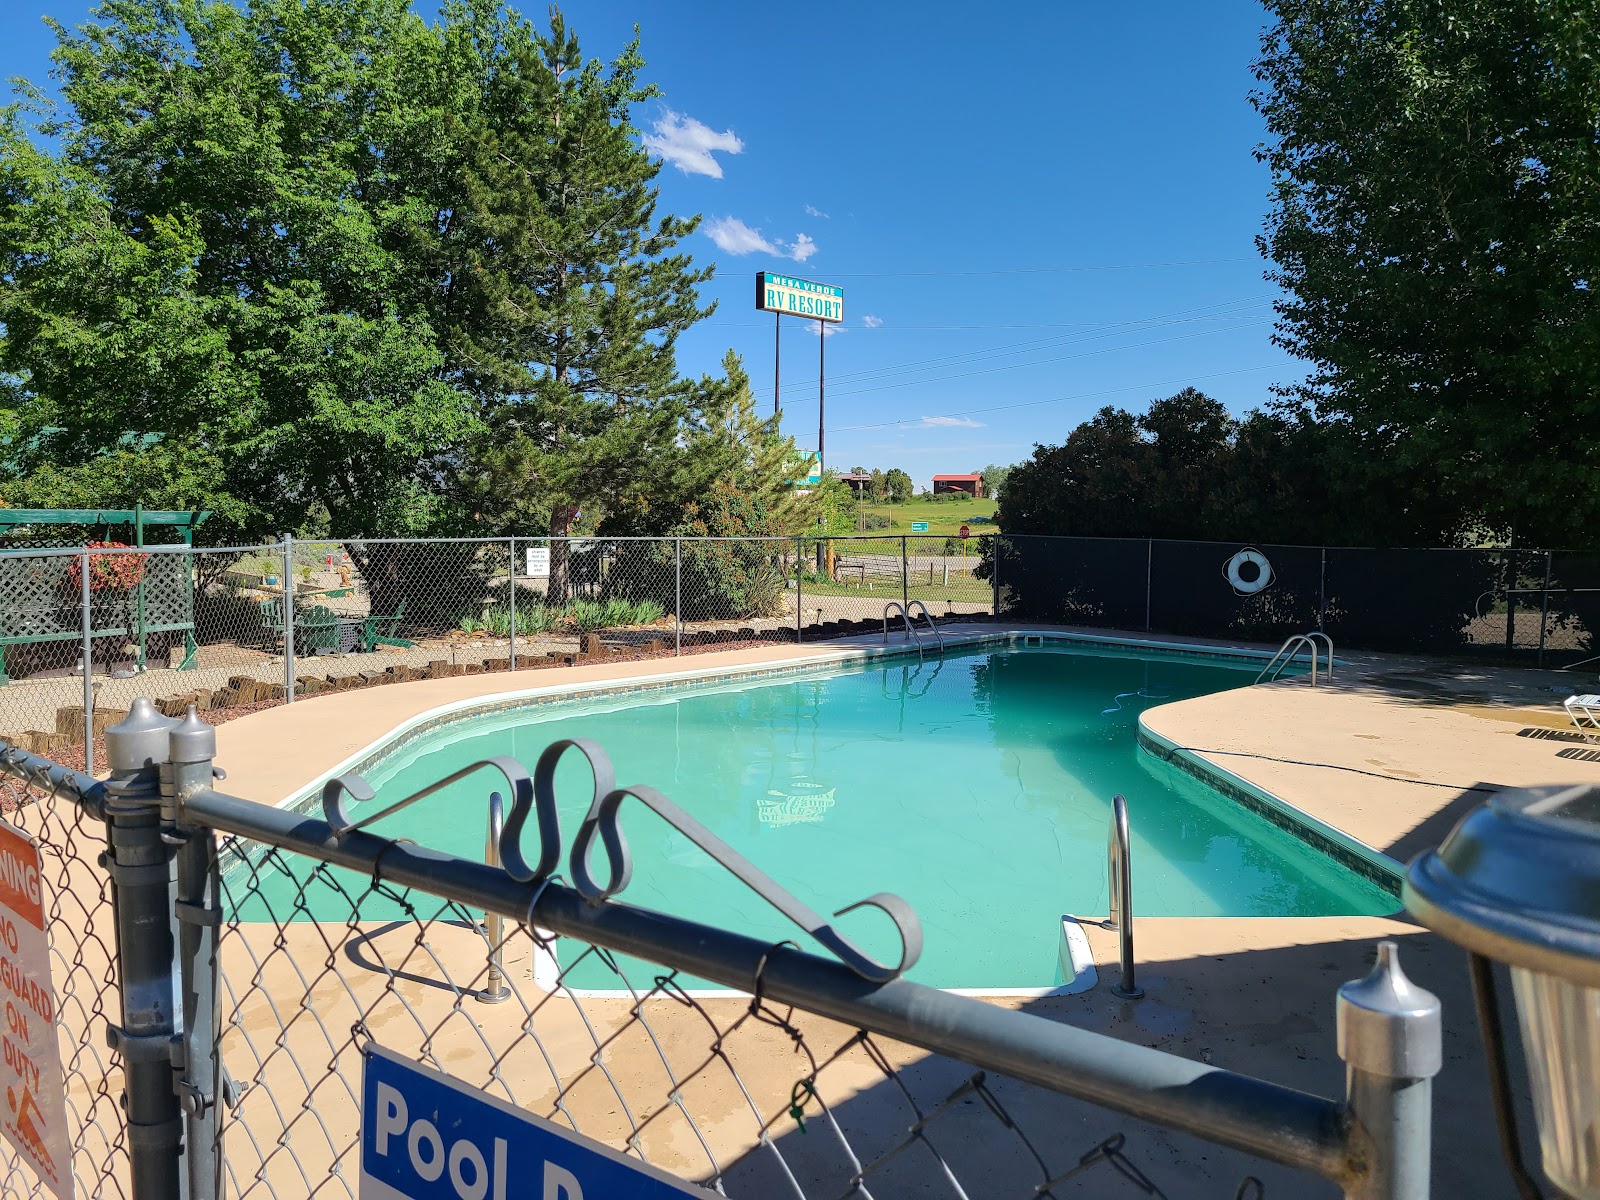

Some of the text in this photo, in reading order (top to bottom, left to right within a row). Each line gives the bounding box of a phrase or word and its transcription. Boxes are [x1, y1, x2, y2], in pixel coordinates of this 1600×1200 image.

[767, 288, 840, 318] RV RESORT
[772, 276, 836, 296] MESA VERDE
[960, 529, 970, 537] STOP
[0, 849, 40, 906] NING
[0, 956, 52, 1024] GUARD
[6, 1000, 30, 1047] ON
[2, 1034, 40, 1094] DUTY
[375, 1080, 508, 1200] Pool
